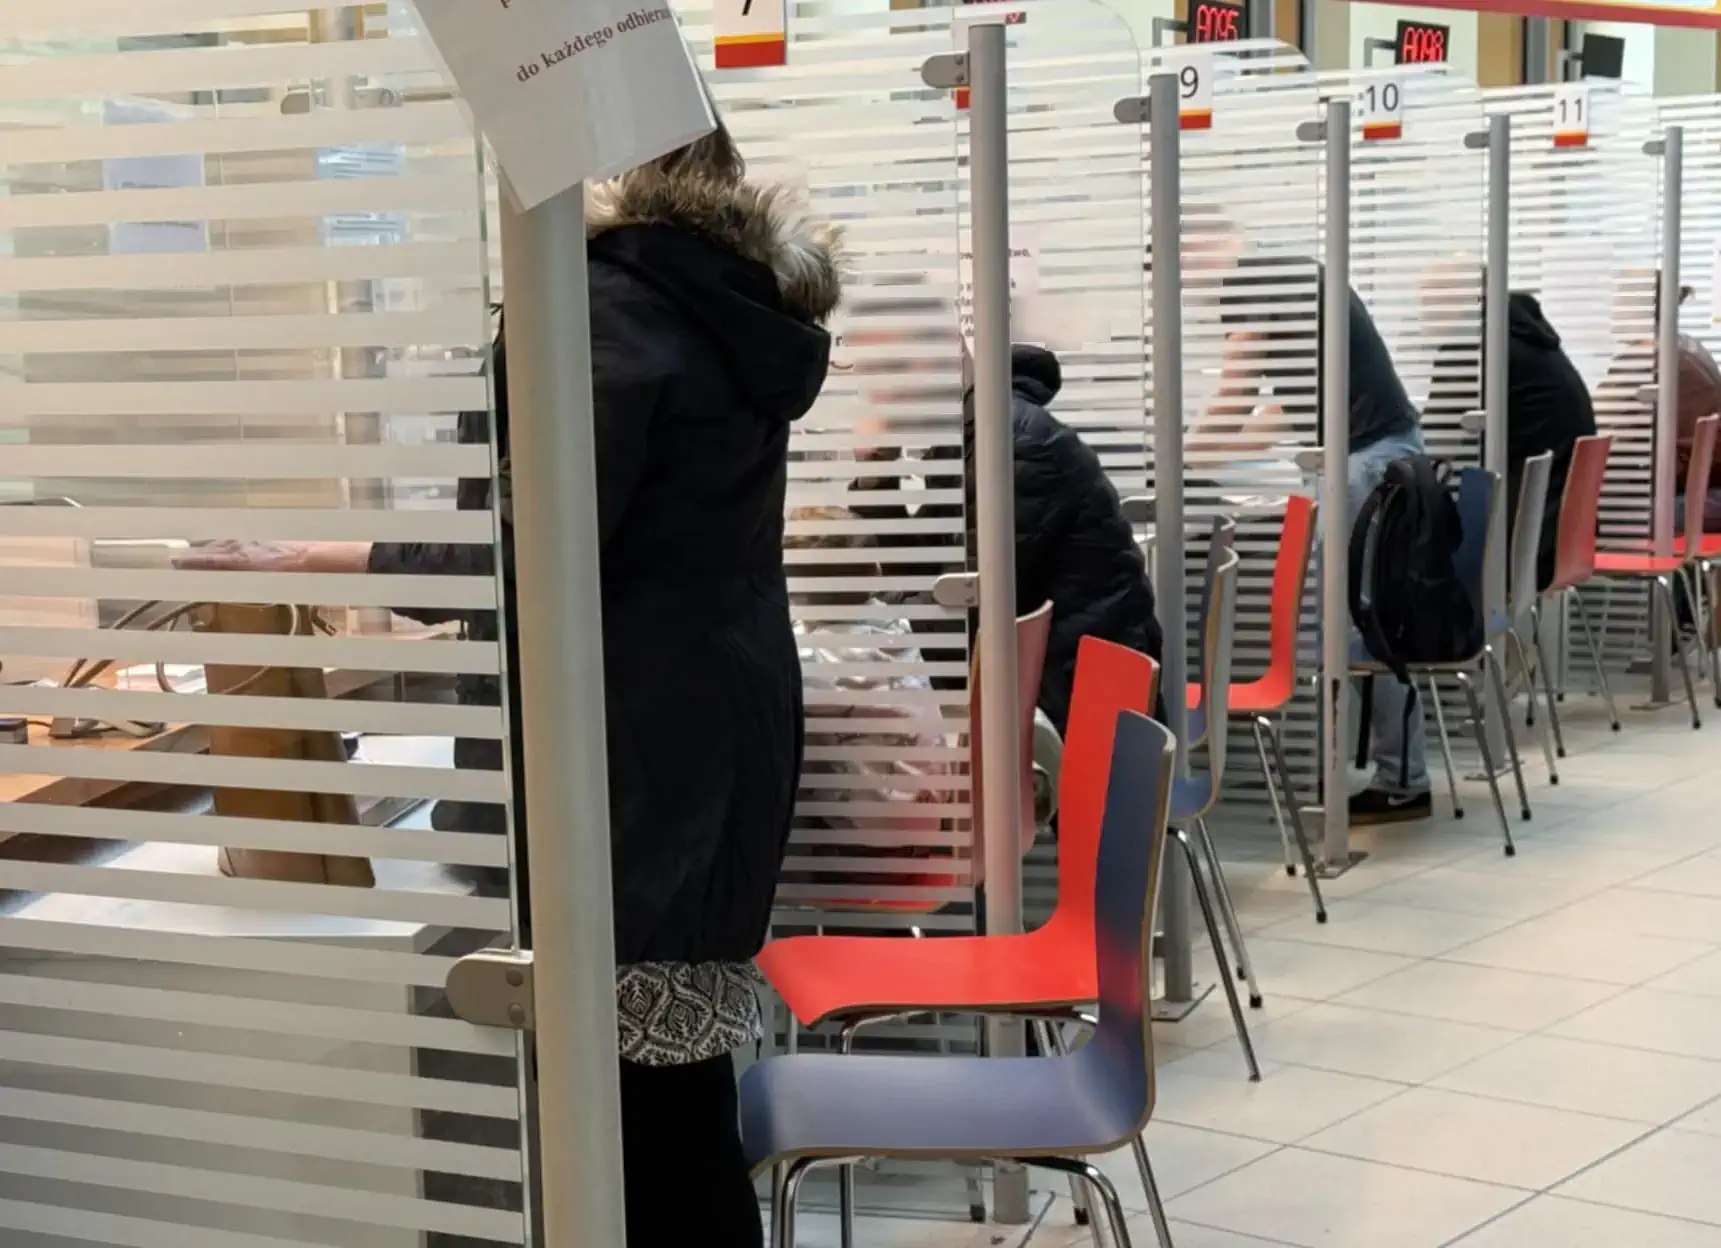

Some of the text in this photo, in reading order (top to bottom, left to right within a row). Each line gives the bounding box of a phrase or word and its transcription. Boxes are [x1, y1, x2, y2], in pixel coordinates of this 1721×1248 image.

[516, 64, 541, 83] do
[540, 25, 614, 69] każdego
[1180, 65, 1199, 99] 9
[1365, 83, 1399, 113] 10
[1558, 97, 1583, 124] 11
